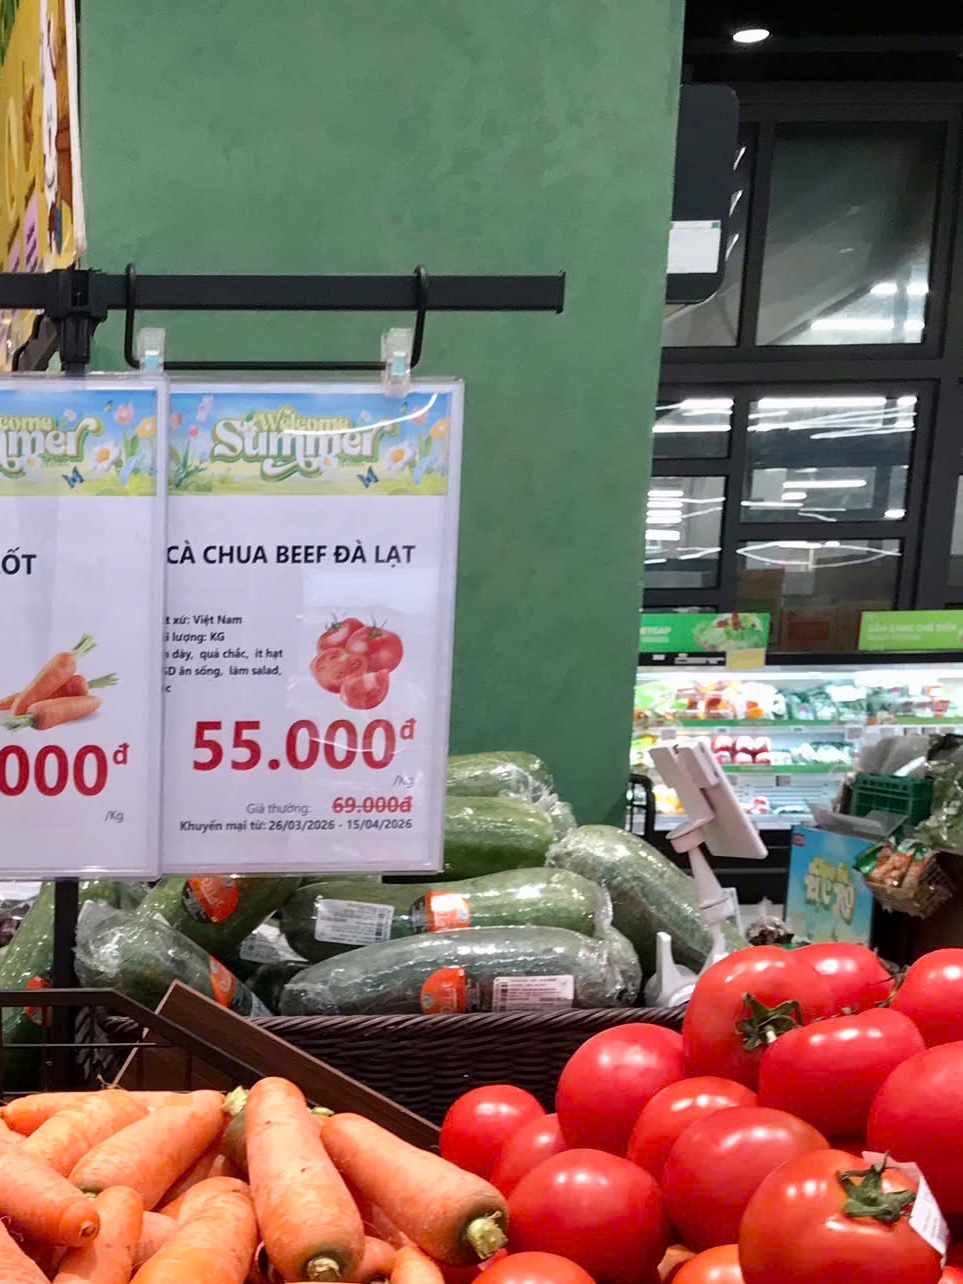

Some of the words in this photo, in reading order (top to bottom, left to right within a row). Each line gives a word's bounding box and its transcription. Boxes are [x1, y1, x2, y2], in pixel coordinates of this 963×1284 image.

[254, 406, 350, 431] Welcome
[211, 417, 398, 481] Summer
[166, 540, 195, 564] CÀ
[203, 545, 268, 564] CHUA
[276, 545, 327, 564] BEEF
[333, 540, 366, 563] ĐÀ
[374, 545, 416, 568] LẠT
[193, 614, 214, 627] Việt
[217, 615, 242, 625] Nam
[172, 632, 207, 644] lượng:
[210, 632, 225, 642] KG
[222, 647, 249, 659] chắc,
[266, 648, 283, 660] hạt
[195, 664, 223, 678] sống,
[229, 665, 249, 675] làm
[251, 665, 282, 676] salad,
[246, 802, 265, 815] Giá
[267, 802, 312, 816] thường:
[332, 795, 413, 813] 69.000đ
[104, 810, 124, 823] /Kg
[179, 820, 222, 833] Khuyến
[225, 819, 247, 833] mại
[250, 818, 266, 831] từ:
[268, 819, 335, 831] 26/03/2026
[347, 818, 413, 831] 15/04/2026
